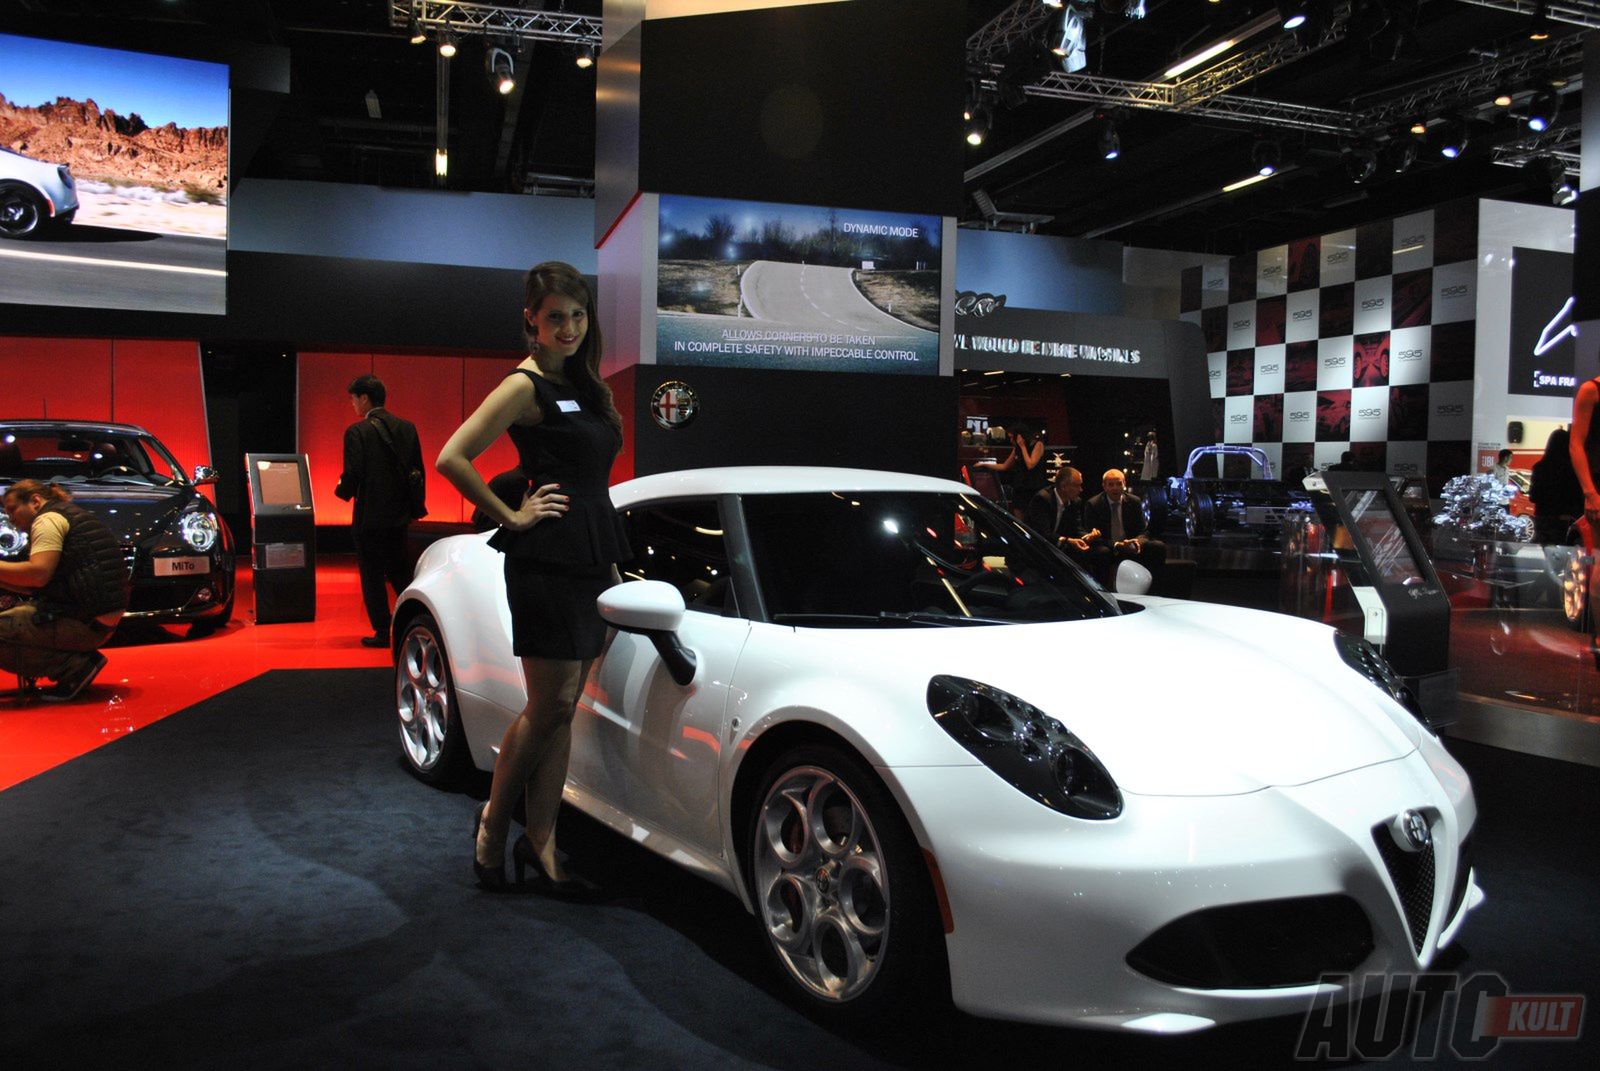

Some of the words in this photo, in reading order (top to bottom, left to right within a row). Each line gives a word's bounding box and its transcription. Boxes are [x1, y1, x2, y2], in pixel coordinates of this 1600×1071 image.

[843, 222, 888, 236] DYNAMIC
[889, 226, 919, 238] MODE
[1361, 298, 1384, 309] 595
[1292, 309, 1312, 319] 595
[722, 329, 762, 341] ALLOWS
[763, 330, 813, 343] CORNERS
[814, 333, 828, 343] TO
[829, 334, 843, 344] BE
[845, 335, 876, 346] TAKEN
[674, 341, 685, 351] IN
[687, 341, 743, 354] COMPLETE
[744, 343, 783, 355] SAFETY
[784, 345, 809, 356] WITH
[811, 347, 873, 359] IMPECCABLE
[874, 350, 919, 361] CONTROL
[1398, 349, 1423, 360] 595
[1324, 357, 1346, 367] 595
[1260, 364, 1279, 373] 595
[1539, 375, 1557, 386] SPA
[1289, 411, 1310, 420] 595
[1359, 408, 1382, 417] 595
[1230, 414, 1248, 422] 595
[171, 561, 195, 571] MiTo
